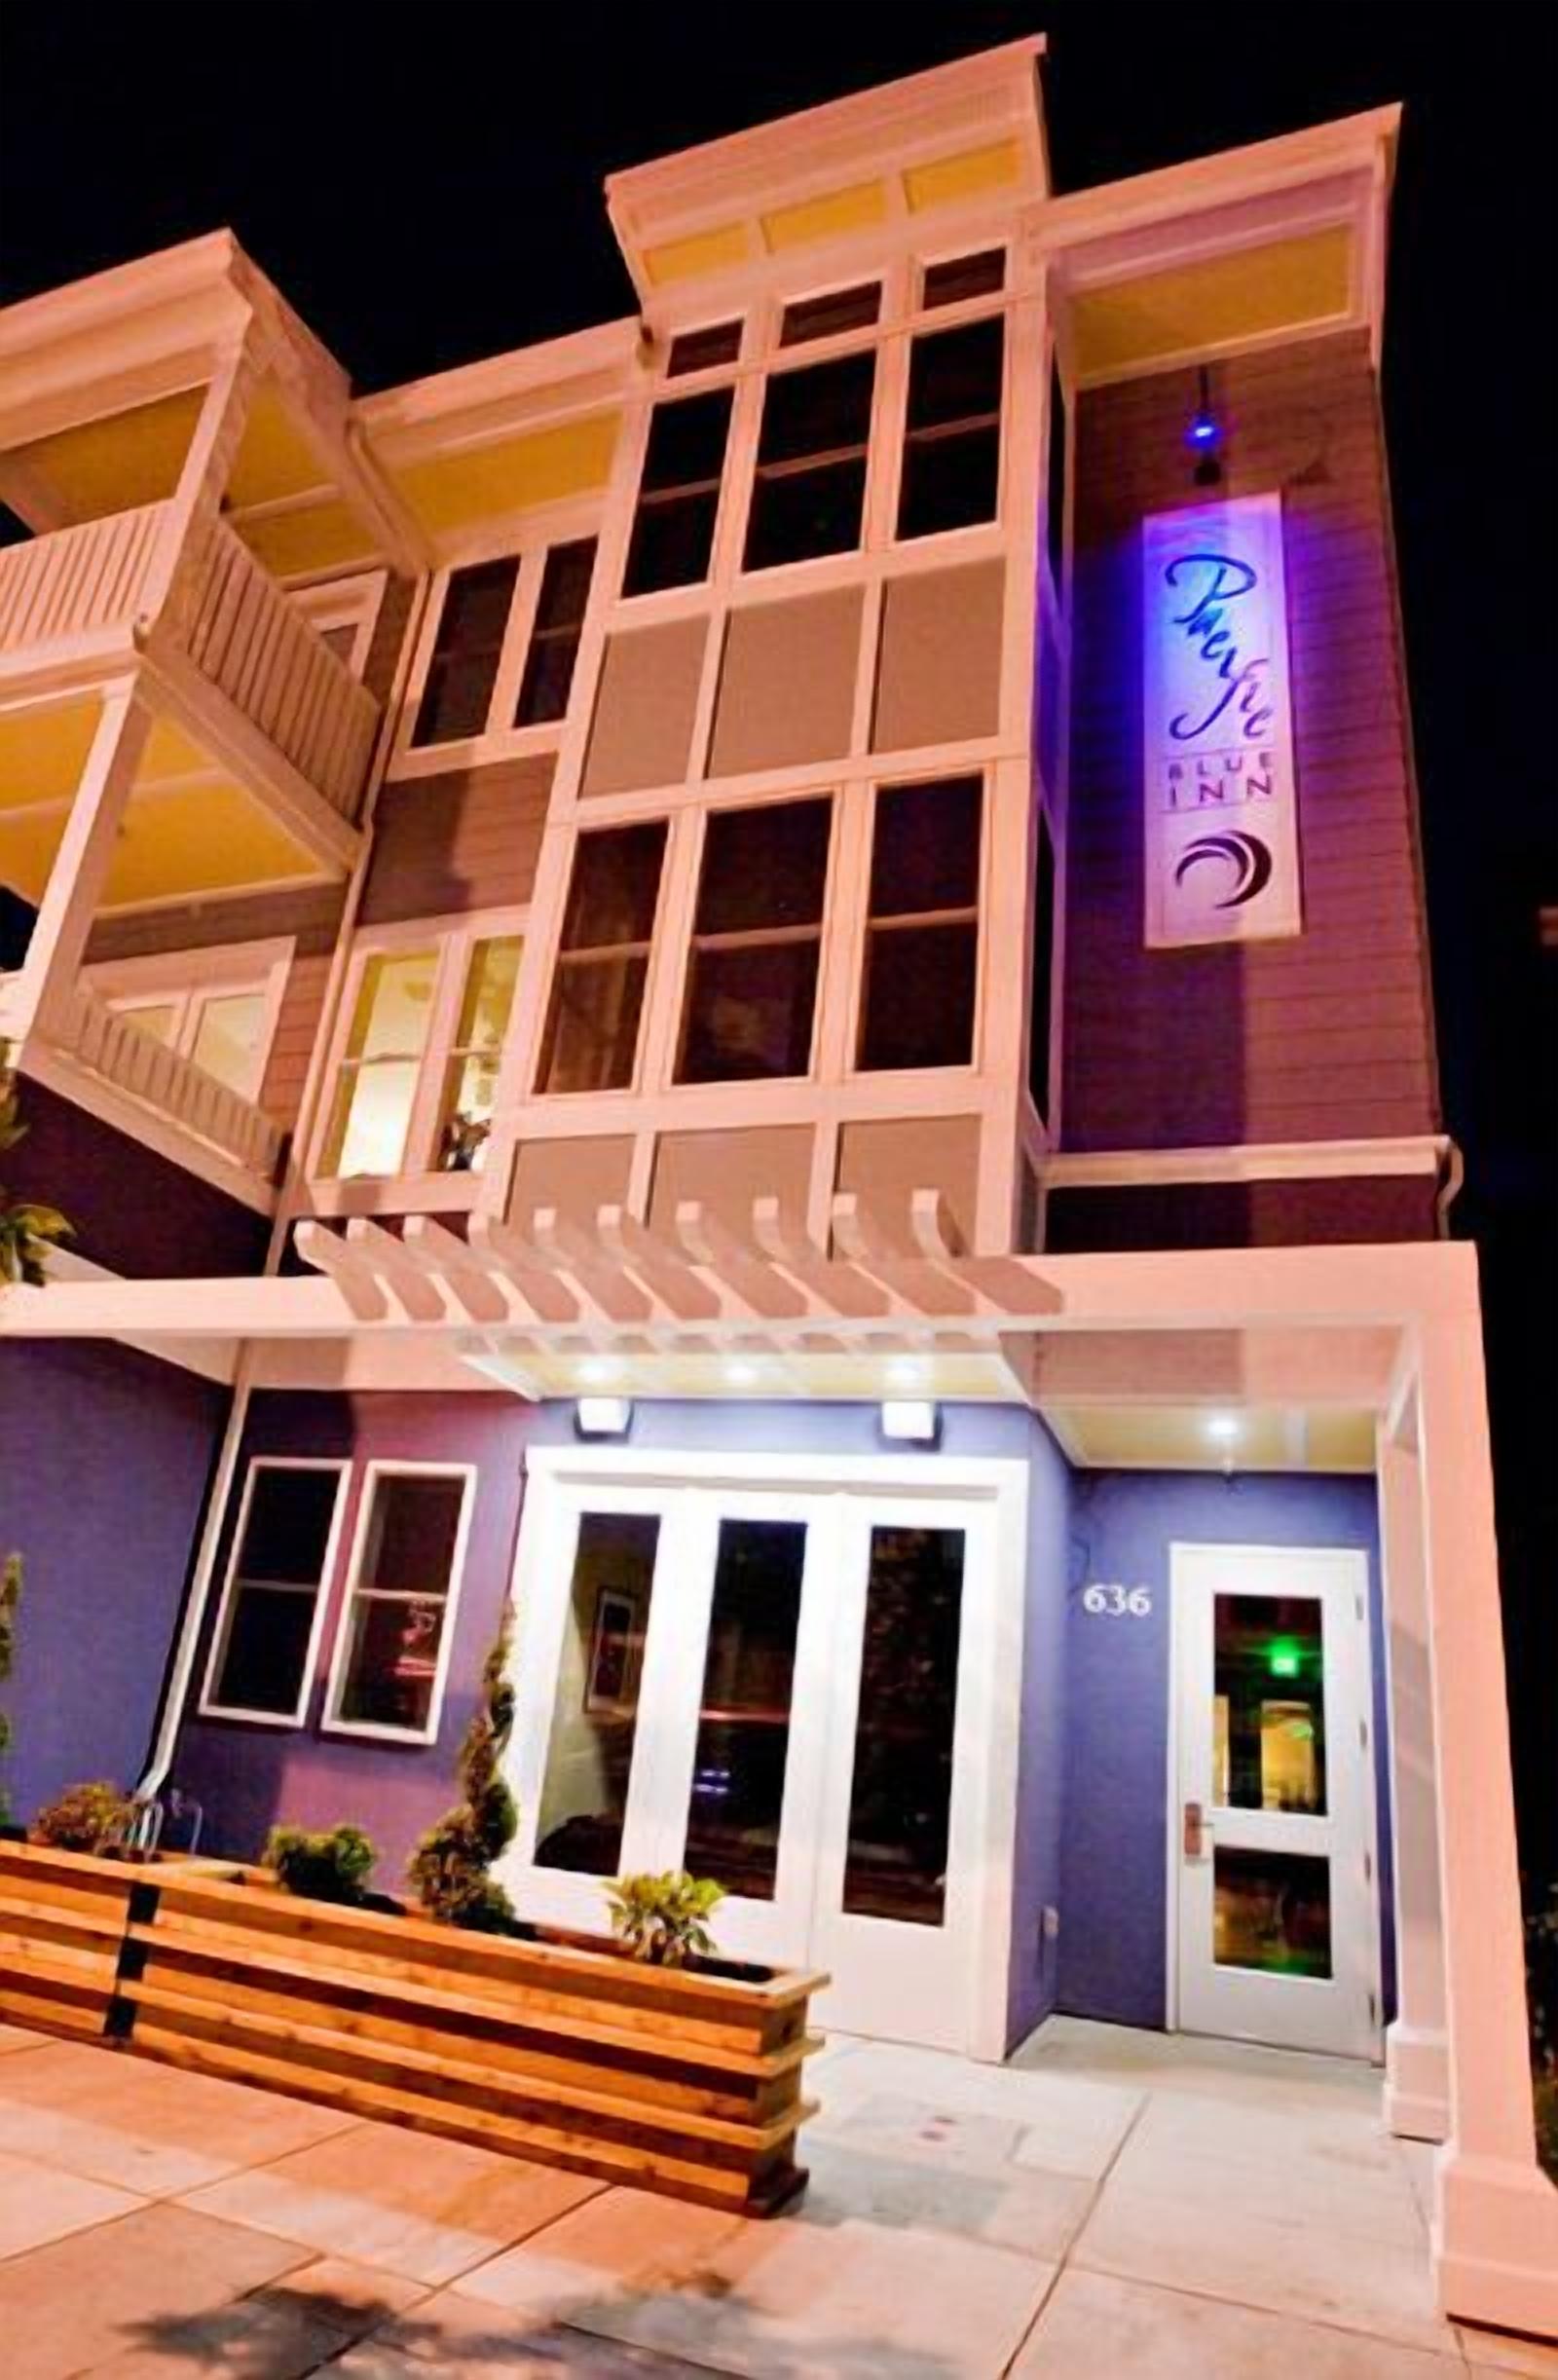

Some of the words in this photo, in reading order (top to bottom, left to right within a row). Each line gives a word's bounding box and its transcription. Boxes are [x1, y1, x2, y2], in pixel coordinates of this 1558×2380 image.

[1168, 752, 1272, 780] BLUE
[1170, 774, 1272, 807] INN
[1083, 1583, 1152, 1617] 636
